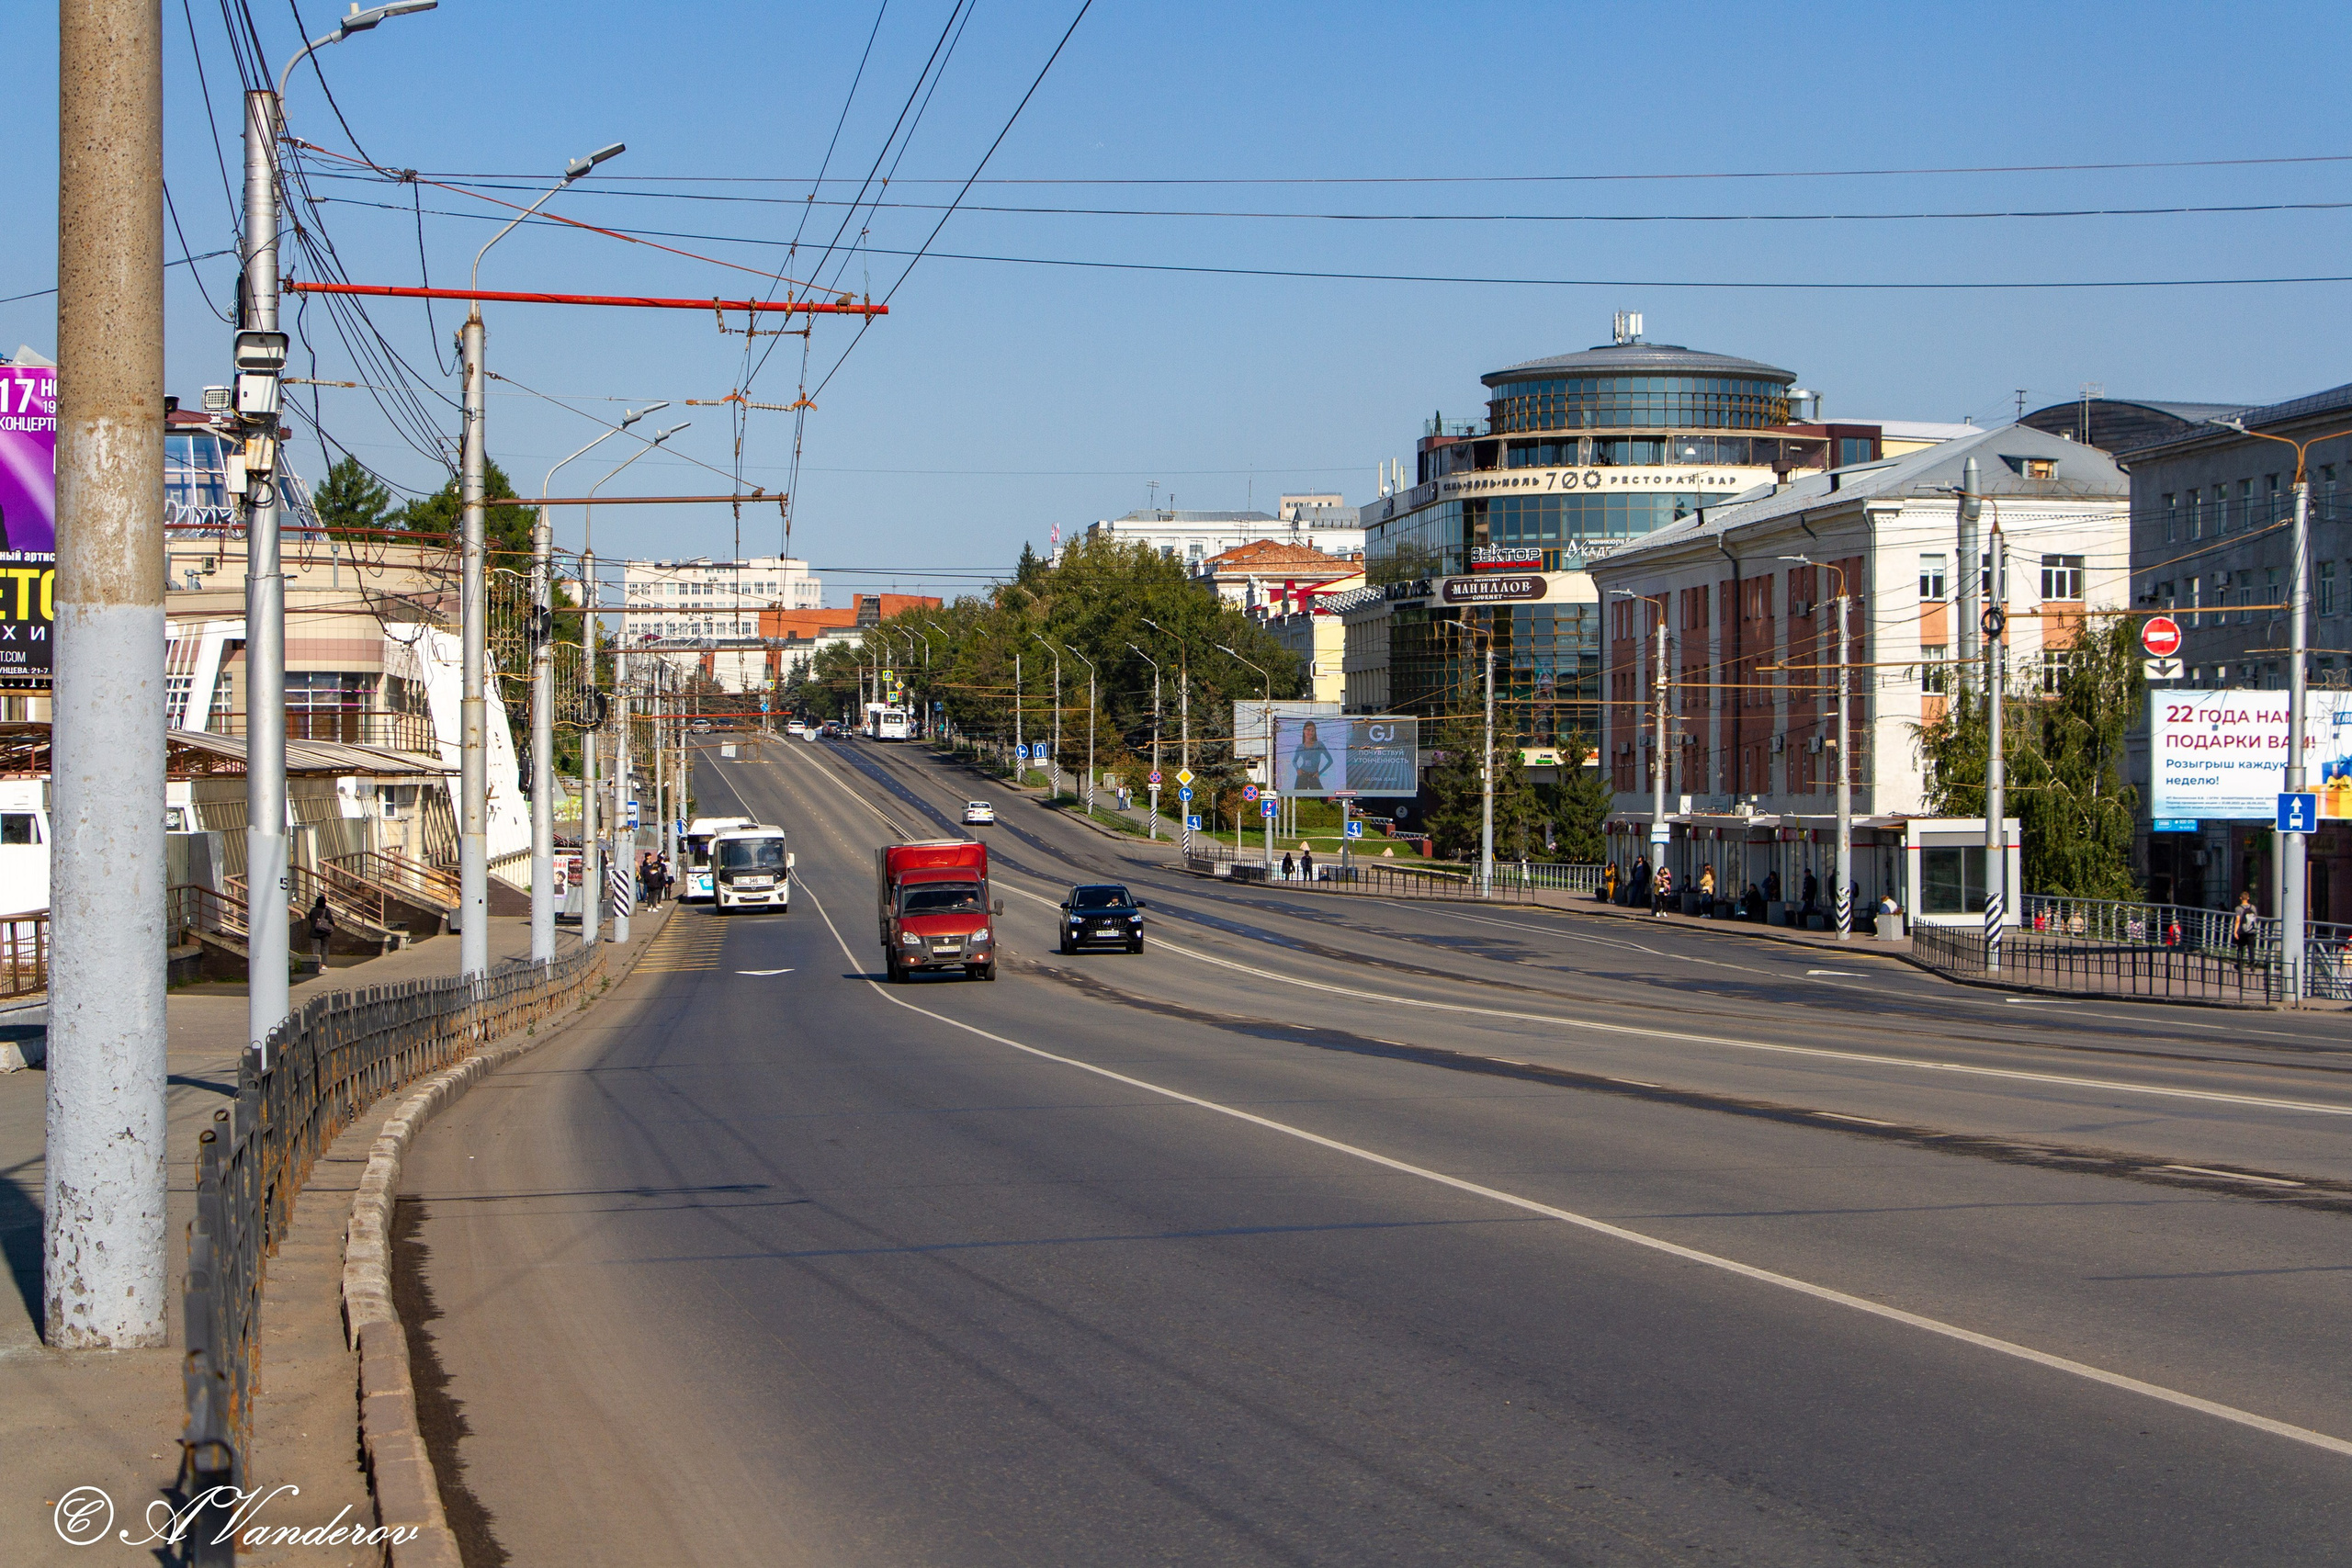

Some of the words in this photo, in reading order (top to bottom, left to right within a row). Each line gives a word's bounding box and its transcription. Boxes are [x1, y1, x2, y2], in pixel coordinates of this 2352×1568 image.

[0, 378, 36, 413] 17
[1453, 581, 1531, 595] МАНИЛЛОВ
[2166, 705, 2193, 722] 22
[2199, 710, 2250, 725] ГОДА
[1369, 724, 1395, 742] GJ
[2166, 735, 2260, 750] ПОДАРКИ
[2166, 759, 2234, 771] Розыгрыш
[2165, 776, 2220, 786] неделю!
[280, 877, 288, 890] 5
